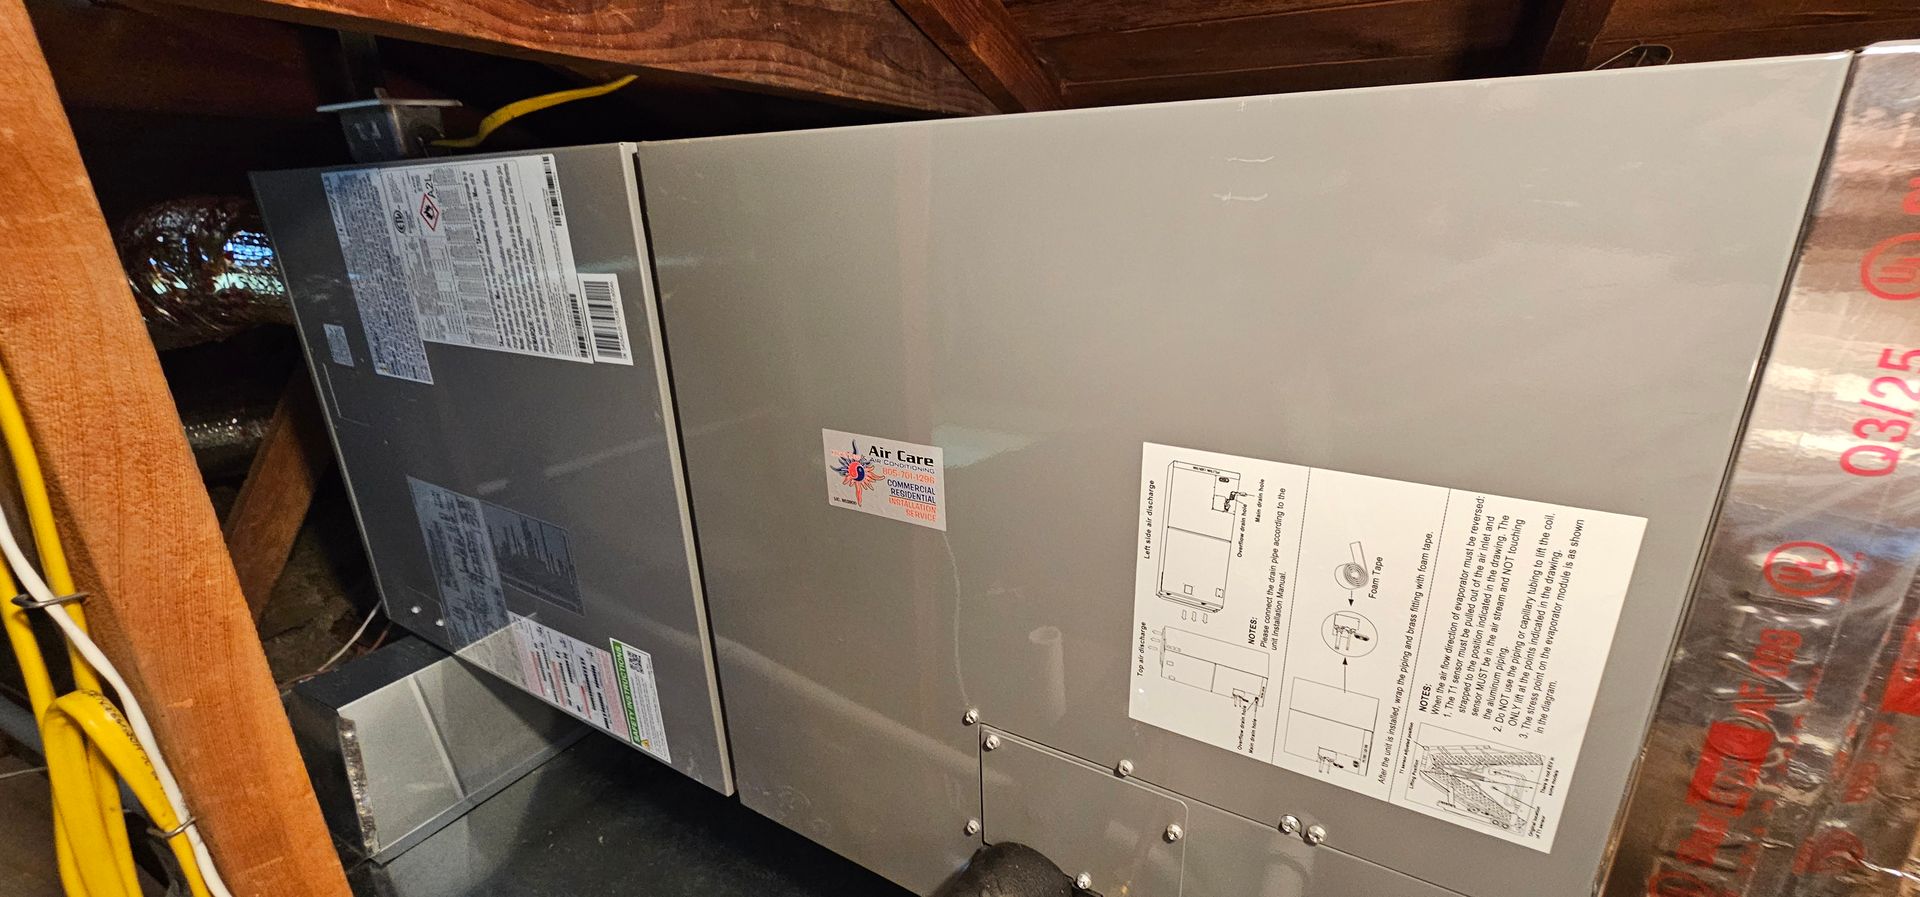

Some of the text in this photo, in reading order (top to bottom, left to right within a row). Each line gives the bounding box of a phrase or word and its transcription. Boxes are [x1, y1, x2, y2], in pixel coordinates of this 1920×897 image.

[427, 172, 436, 198] A2L
[1839, 348, 1920, 477] Q3/25
[869, 445, 891, 459] Air
[898, 450, 934, 466] Care
[887, 479, 935, 495] COMMERCIAL
[890, 488, 936, 504] RESIDENTIAL
[1146, 479, 1156, 516] discharge
[888, 497, 936, 513] INSTALLATION
[906, 506, 936, 522] SERVICE
[1485, 515, 1495, 532] and
[1569, 519, 1584, 547] shown
[1422, 531, 1433, 551] tape.
[1479, 533, 1491, 551] inlet
[1417, 552, 1429, 573] foam
[1477, 552, 1487, 564] air
[1562, 561, 1574, 569] is
[1567, 549, 1577, 560] as
[1260, 487, 1286, 649] Please connect the drain pipe according to the
[1368, 556, 1384, 599] Foam Tape
[1474, 565, 1485, 578] the
[1276, 571, 1286, 599] Manual.
[1416, 574, 1425, 590] with
[1472, 578, 1481, 588] of
[1557, 570, 1571, 601] module
[1410, 591, 1424, 612] fitting
[1431, 495, 1485, 715] When the air flow direction of evaporator must be reversed:
[1470, 589, 1479, 602] out
[1272, 600, 1283, 637] Installation
[1406, 613, 1418, 635] brass
[1458, 515, 1510, 714] strapped to the position indicated in the drawing. The
[1465, 603, 1476, 627] pulled
[1472, 519, 1526, 716] sensor MUST be in the air stream and NOT touching
[1493, 513, 1556, 733] 2. Do NOT use the piping or capillary tubing to lift the coil.
[1545, 602, 1563, 645] evaporator
[1138, 621, 1147, 654] discharge
[1248, 616, 1258, 645] NOTES:
[1460, 628, 1471, 638] be
[1508, 550, 1563, 727] ONLY lift at the points indicated in the drawing.
[1405, 634, 1413, 650] and
[1458, 639, 1468, 658] must
[1540, 646, 1551, 659] the
[1137, 664, 1145, 676] Top
[1400, 650, 1412, 674] piping
[1452, 658, 1464, 684] sensor
[1539, 660, 1547, 671] on
[1397, 673, 1406, 686] the
[1448, 685, 1458, 694] T1
[1482, 646, 1510, 720] the aluminum piping.
[1533, 671, 1545, 692] point
[615, 646, 641, 742] SAFETY INSTRUCTIONS
[1395, 686, 1405, 704] wrap
[1419, 683, 1432, 712] NOTES:
[1445, 696, 1456, 709] The
[1527, 692, 1539, 715] stress
[1534, 680, 1557, 734] in the diagram.
[1387, 705, 1401, 735] installed,
[1521, 715, 1533, 729] The
[1384, 742, 1393, 756] unit
[1381, 756, 1390, 768] the
[1378, 767, 1387, 785] After
